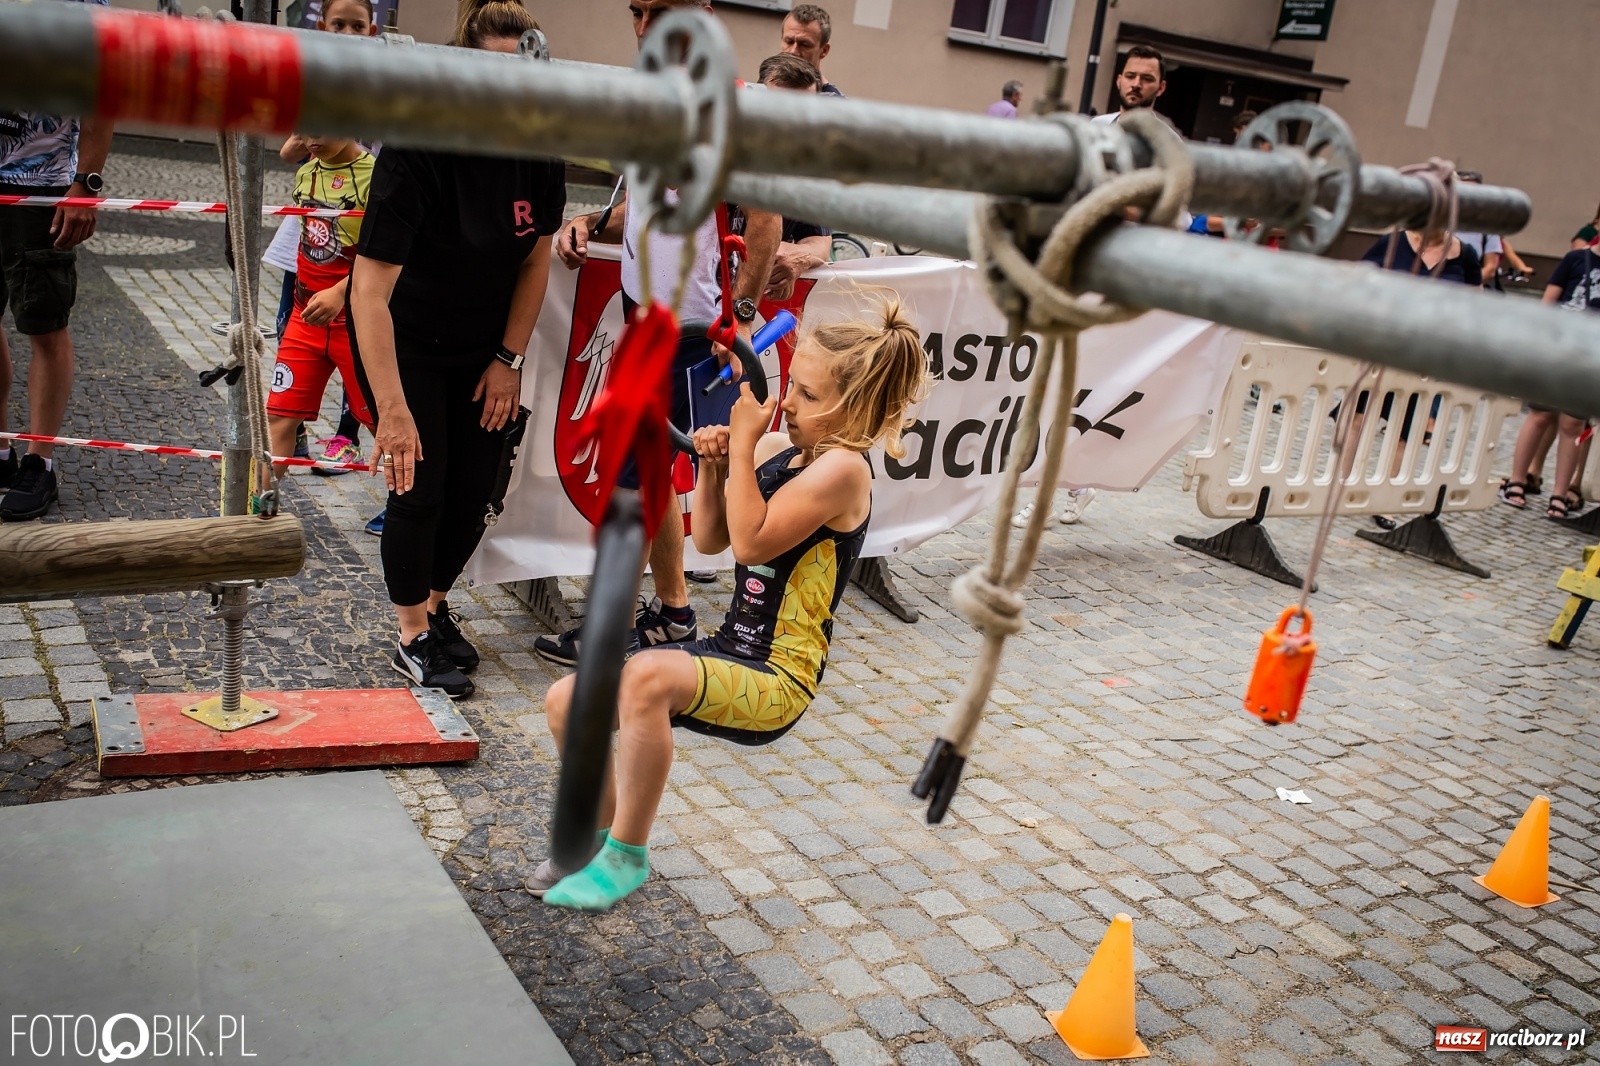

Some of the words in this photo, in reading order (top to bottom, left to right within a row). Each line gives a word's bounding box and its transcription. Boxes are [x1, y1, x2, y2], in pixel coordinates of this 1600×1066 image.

[514, 201, 533, 226] R
[922, 332, 1038, 382] ASTO
[644, 626, 669, 646] N
